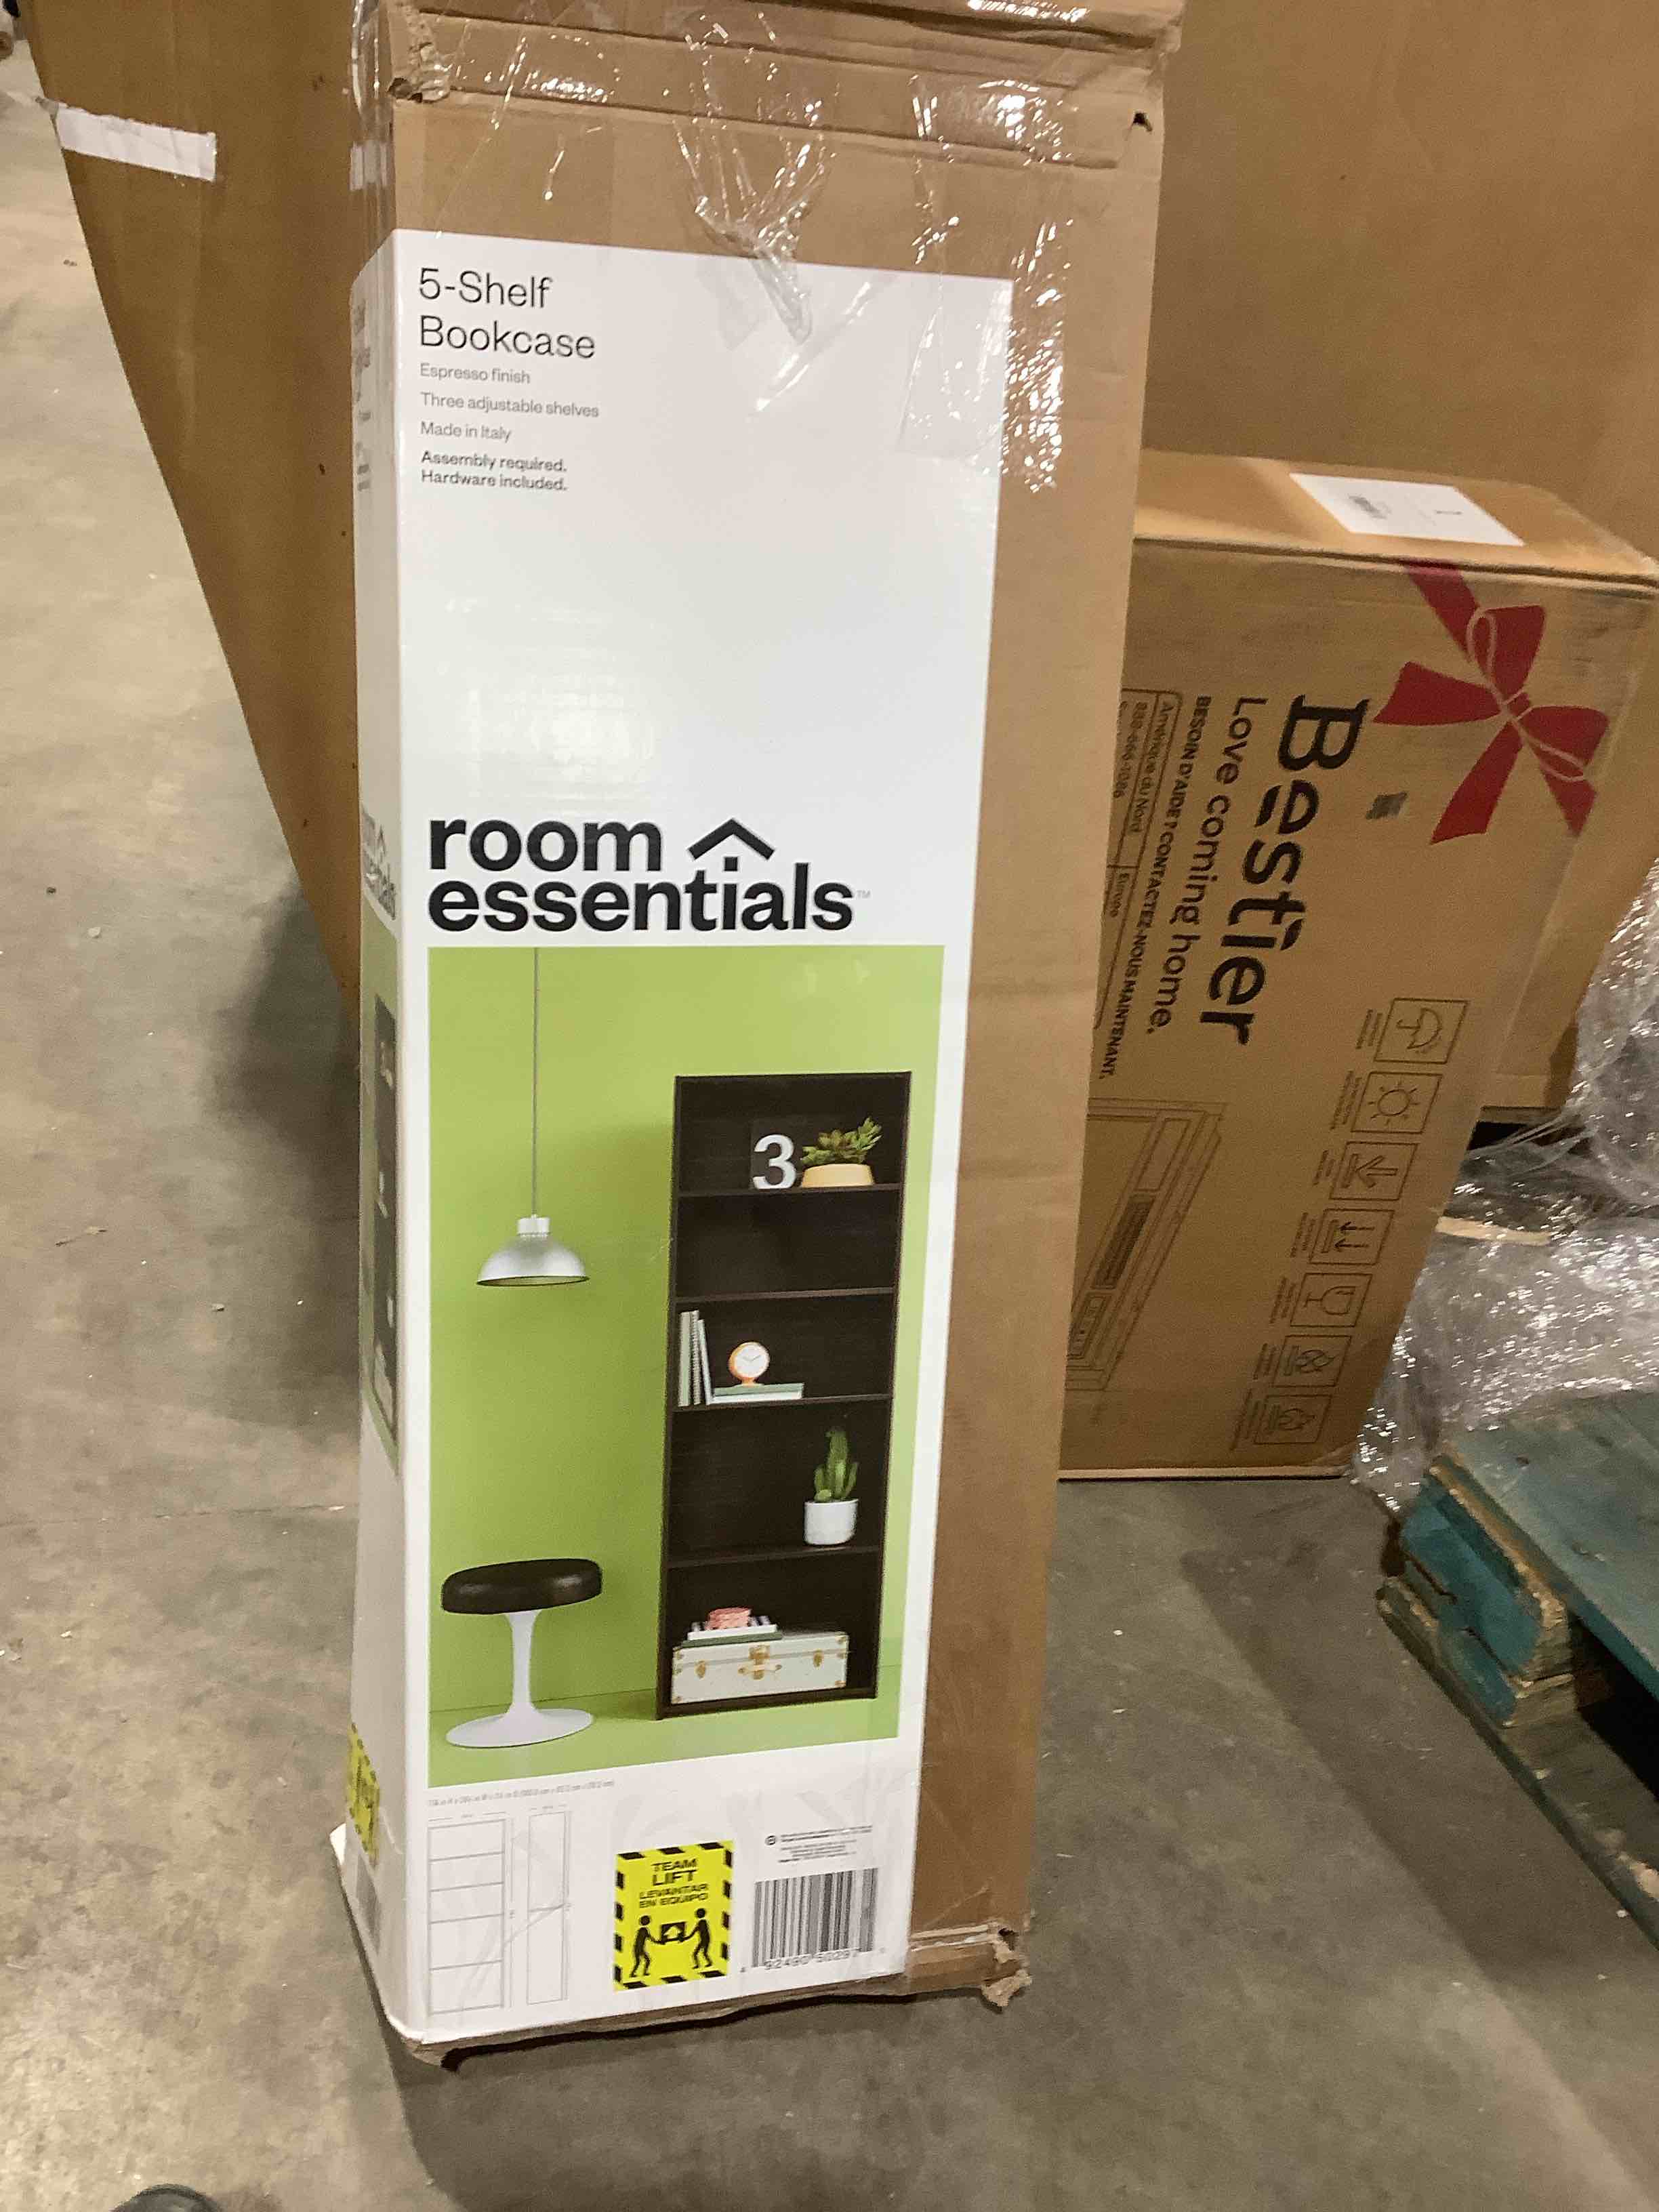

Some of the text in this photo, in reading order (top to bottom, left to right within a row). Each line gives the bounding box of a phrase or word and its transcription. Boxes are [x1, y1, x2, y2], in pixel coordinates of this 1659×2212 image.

[419, 268, 553, 308] 5-Shelf
[420, 315, 595, 359] Bookcase
[420, 363, 531, 384] Espresso finish
[420, 392, 600, 418] Three adjustable shelves
[420, 422, 512, 443] Made in Italy
[422, 451, 567, 474] Assembly required.
[422, 470, 567, 491] Hardware included.
[1181, 696, 1212, 760] BESOIN
[428, 818, 662, 872] room
[1147, 697, 1268, 1034] Love coming home.
[1200, 694, 1370, 1046] Bestier
[428, 857, 855, 932] essentials
[1099, 980, 1136, 1080] MAINTENANT.
[752, 1134, 796, 1189] 3
[651, 1858, 697, 1871] TEAM
[652, 1869, 697, 1886] LIFT
